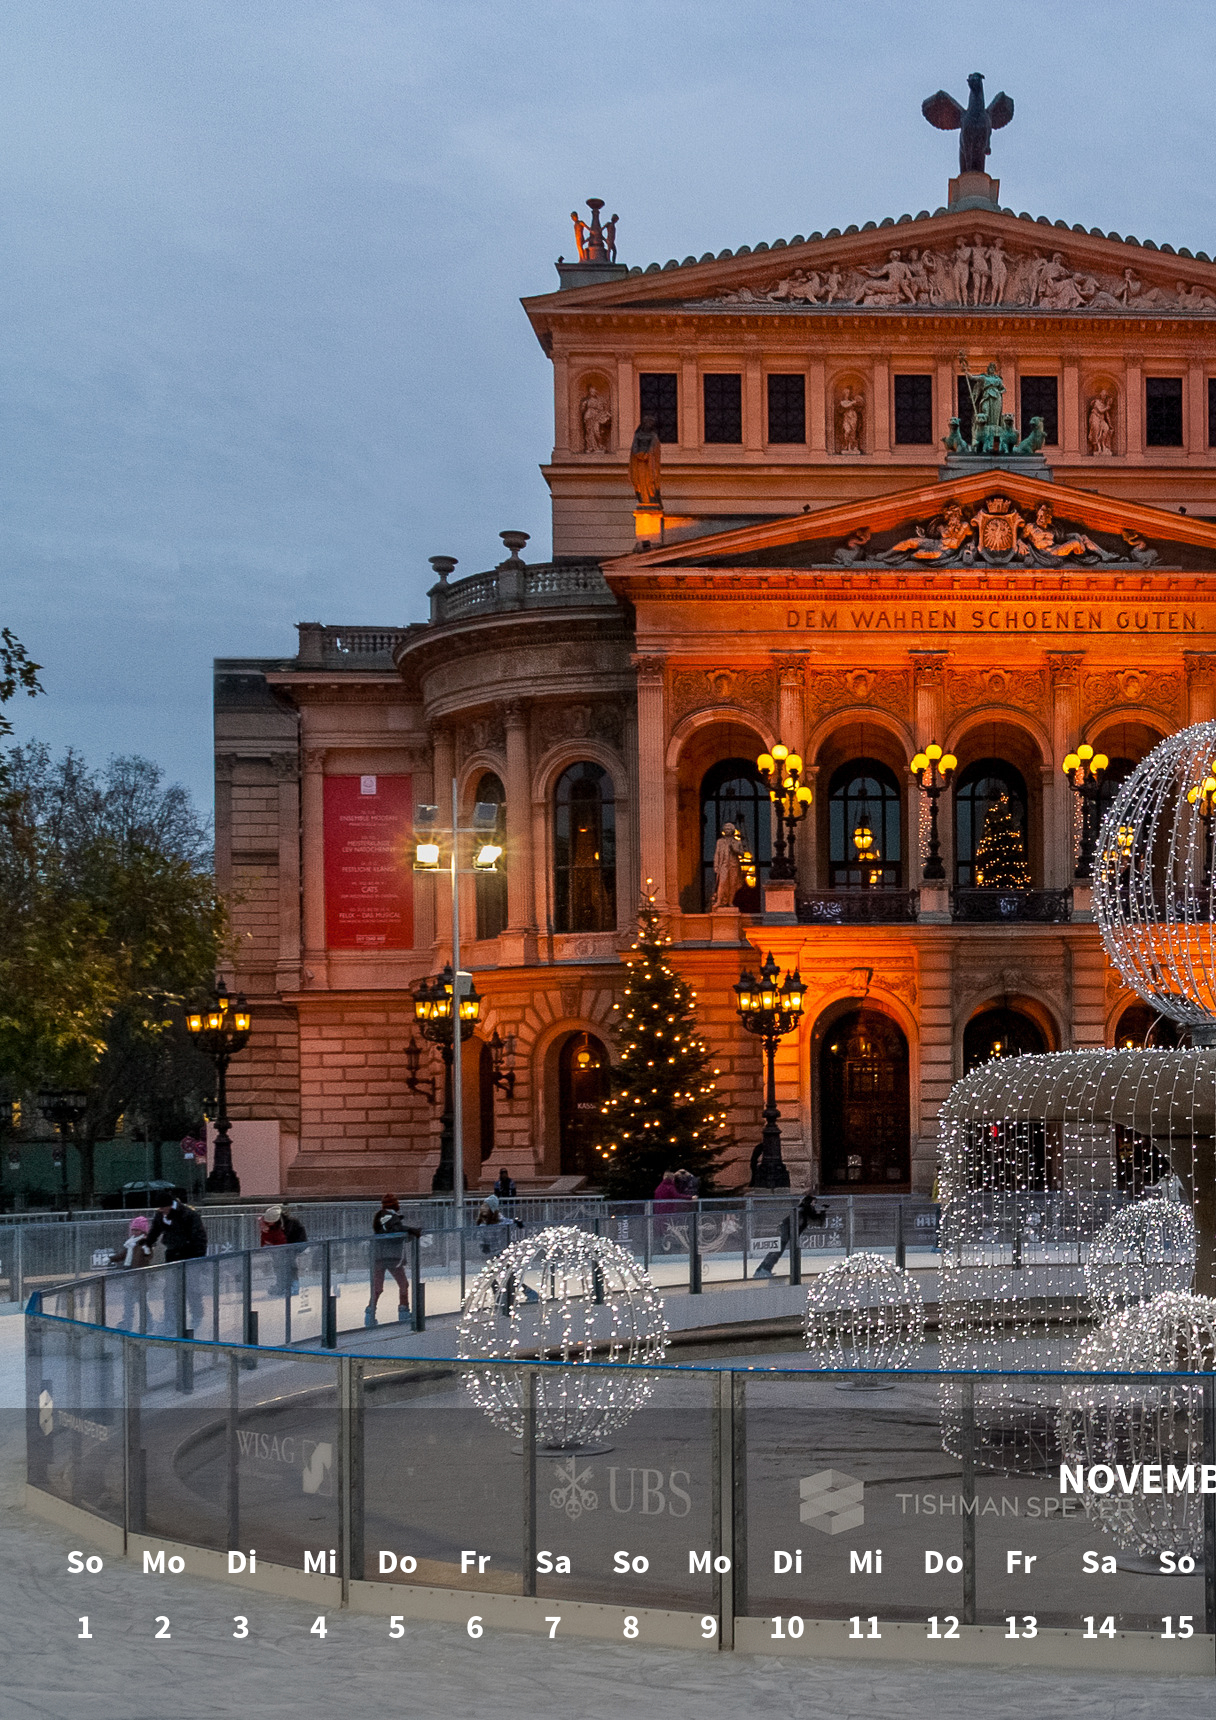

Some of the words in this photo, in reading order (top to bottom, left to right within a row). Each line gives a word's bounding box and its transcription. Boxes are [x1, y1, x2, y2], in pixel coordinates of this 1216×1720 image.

[786, 610, 838, 628] DEM
[851, 610, 956, 629] WAHREN
[972, 611, 1101, 629] SCHOENEN
[1116, 611, 1205, 630] GUTEN.
[235, 1429, 295, 1464] WISAG
[606, 1465, 692, 1518] UBS
[896, 1493, 1019, 1517] TISHMAN
[1026, 1496, 1136, 1519] SPEYER
